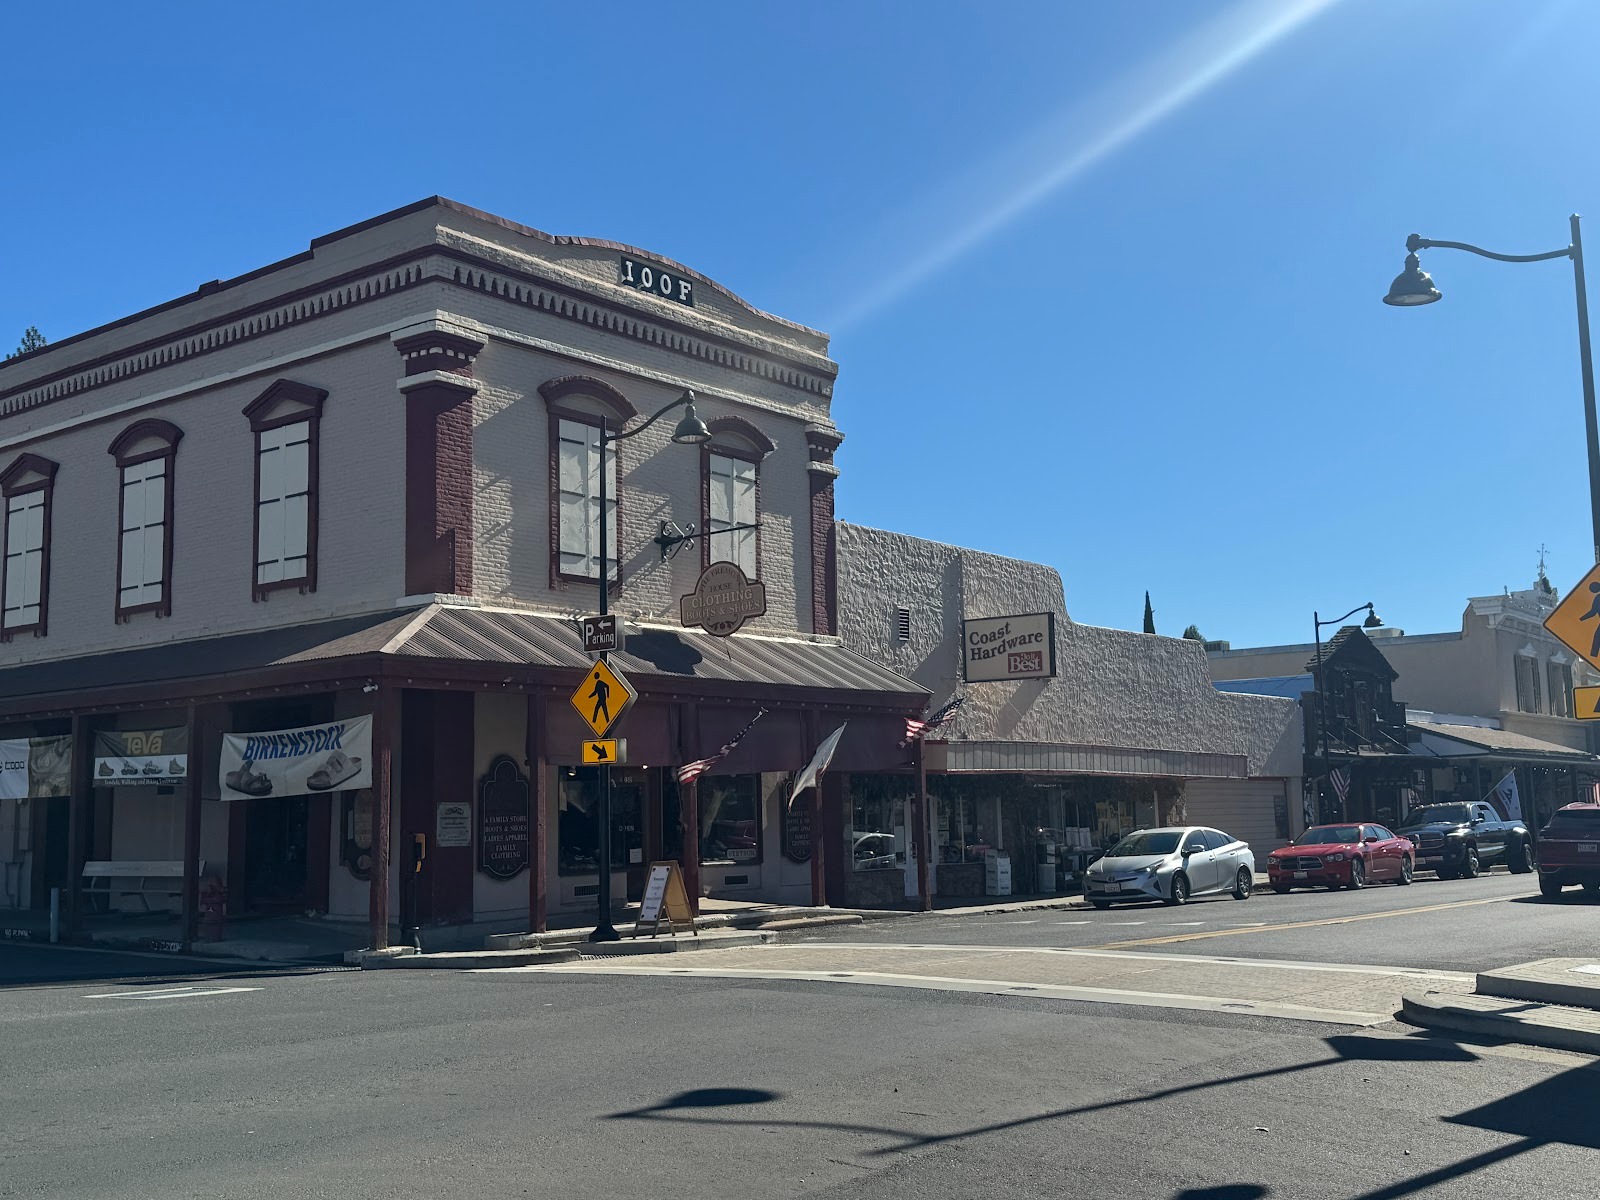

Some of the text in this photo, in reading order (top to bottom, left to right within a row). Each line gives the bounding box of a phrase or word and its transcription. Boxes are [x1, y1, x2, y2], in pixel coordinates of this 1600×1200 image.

[625, 260, 692, 301] IOOF
[710, 583, 732, 592] HOUSE
[692, 589, 752, 608] CLOTHING
[686, 600, 760, 620] BOOTS & SHOES
[586, 624, 614, 645] Parking
[969, 622, 1011, 645] Coast
[970, 632, 1043, 661] Hardware
[1009, 656, 1041, 672] Best
[242, 724, 346, 761] BIRKENSTOCK
[490, 851, 520, 860] CLOTHING
[728, 849, 755, 857] STETSON
